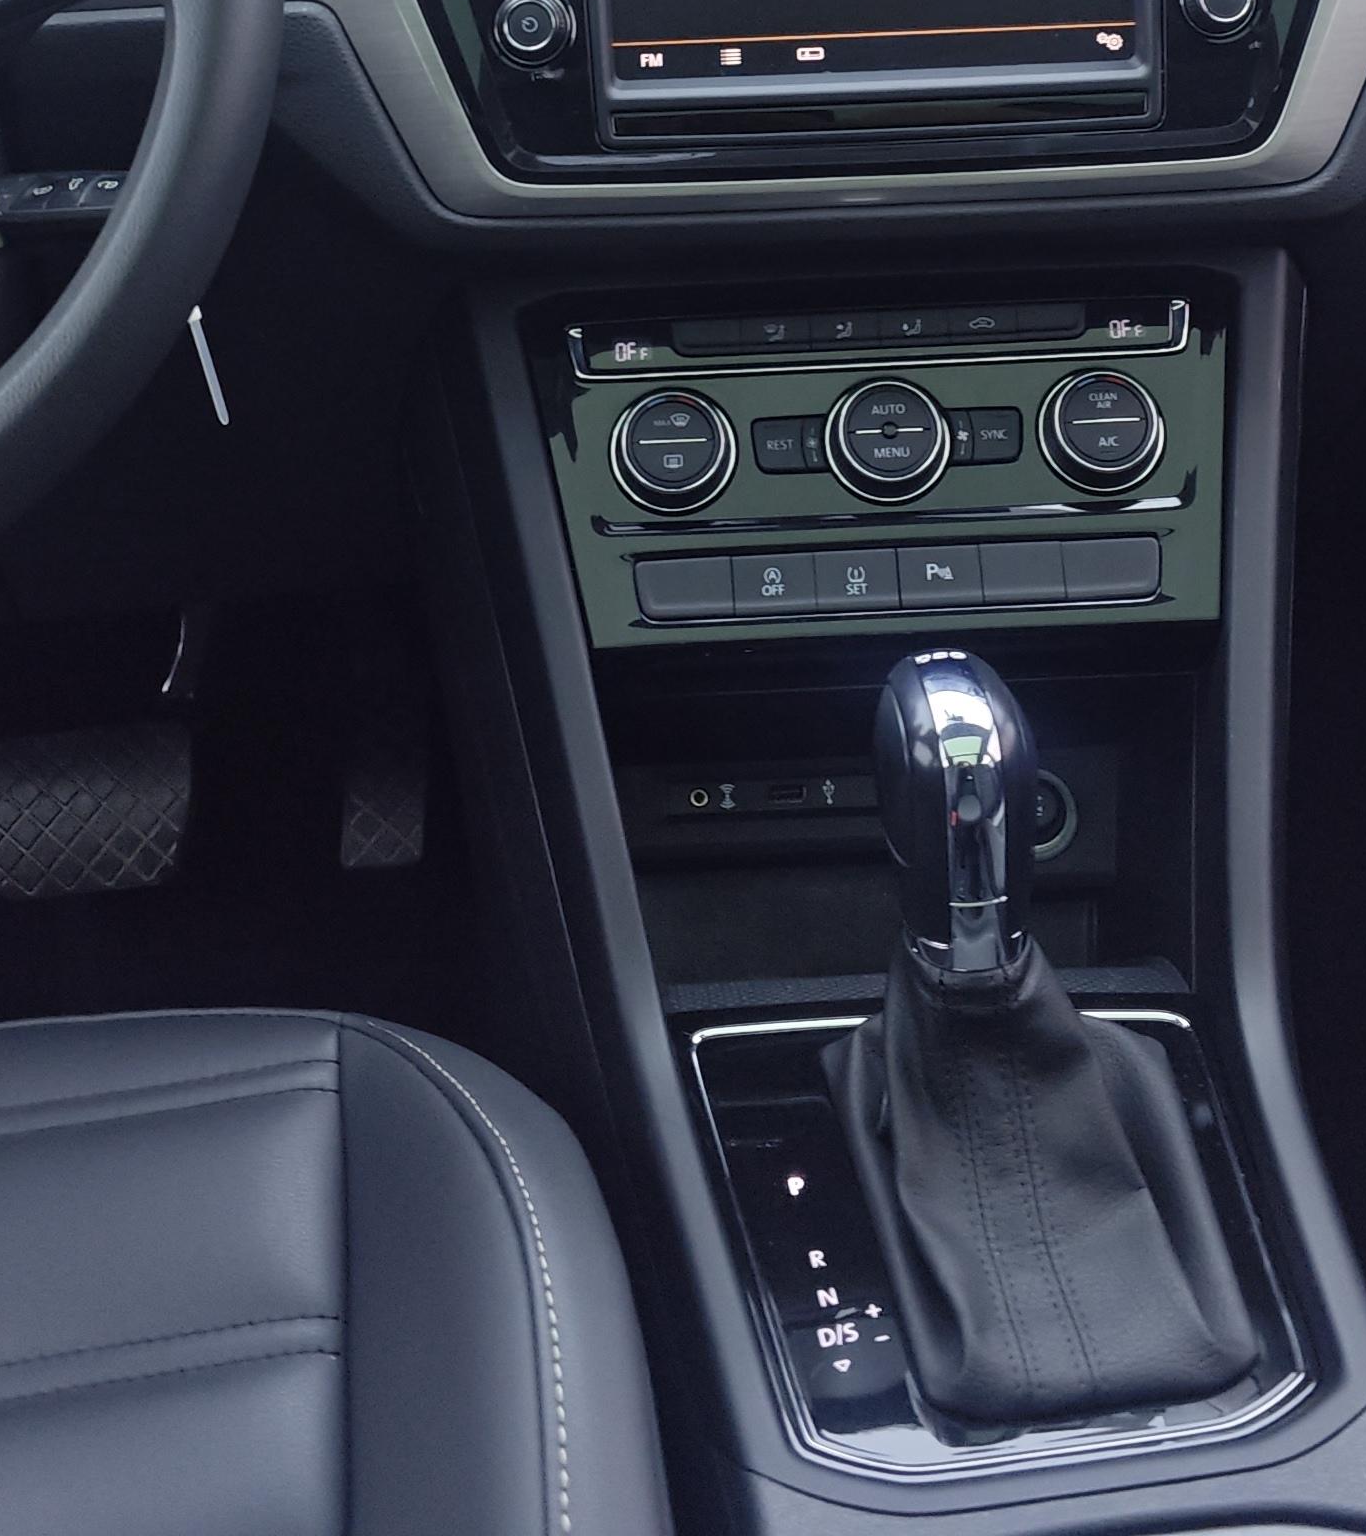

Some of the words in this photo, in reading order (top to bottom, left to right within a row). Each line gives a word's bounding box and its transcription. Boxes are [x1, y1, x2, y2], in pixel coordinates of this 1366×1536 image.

[639, 52, 664, 68] FM
[1088, 392, 1118, 402] CLEAN
[871, 403, 906, 416] AUTO
[1096, 401, 1112, 409] AIR
[980, 428, 1008, 441] SYNC
[1098, 435, 1120, 447] A/C
[766, 439, 793, 451] REST
[873, 446, 910, 459] MENU
[761, 583, 786, 597] OFF
[845, 582, 869, 596] SET
[787, 1176, 805, 1196] P
[808, 1250, 827, 1268] R
[816, 1287, 839, 1307] N
